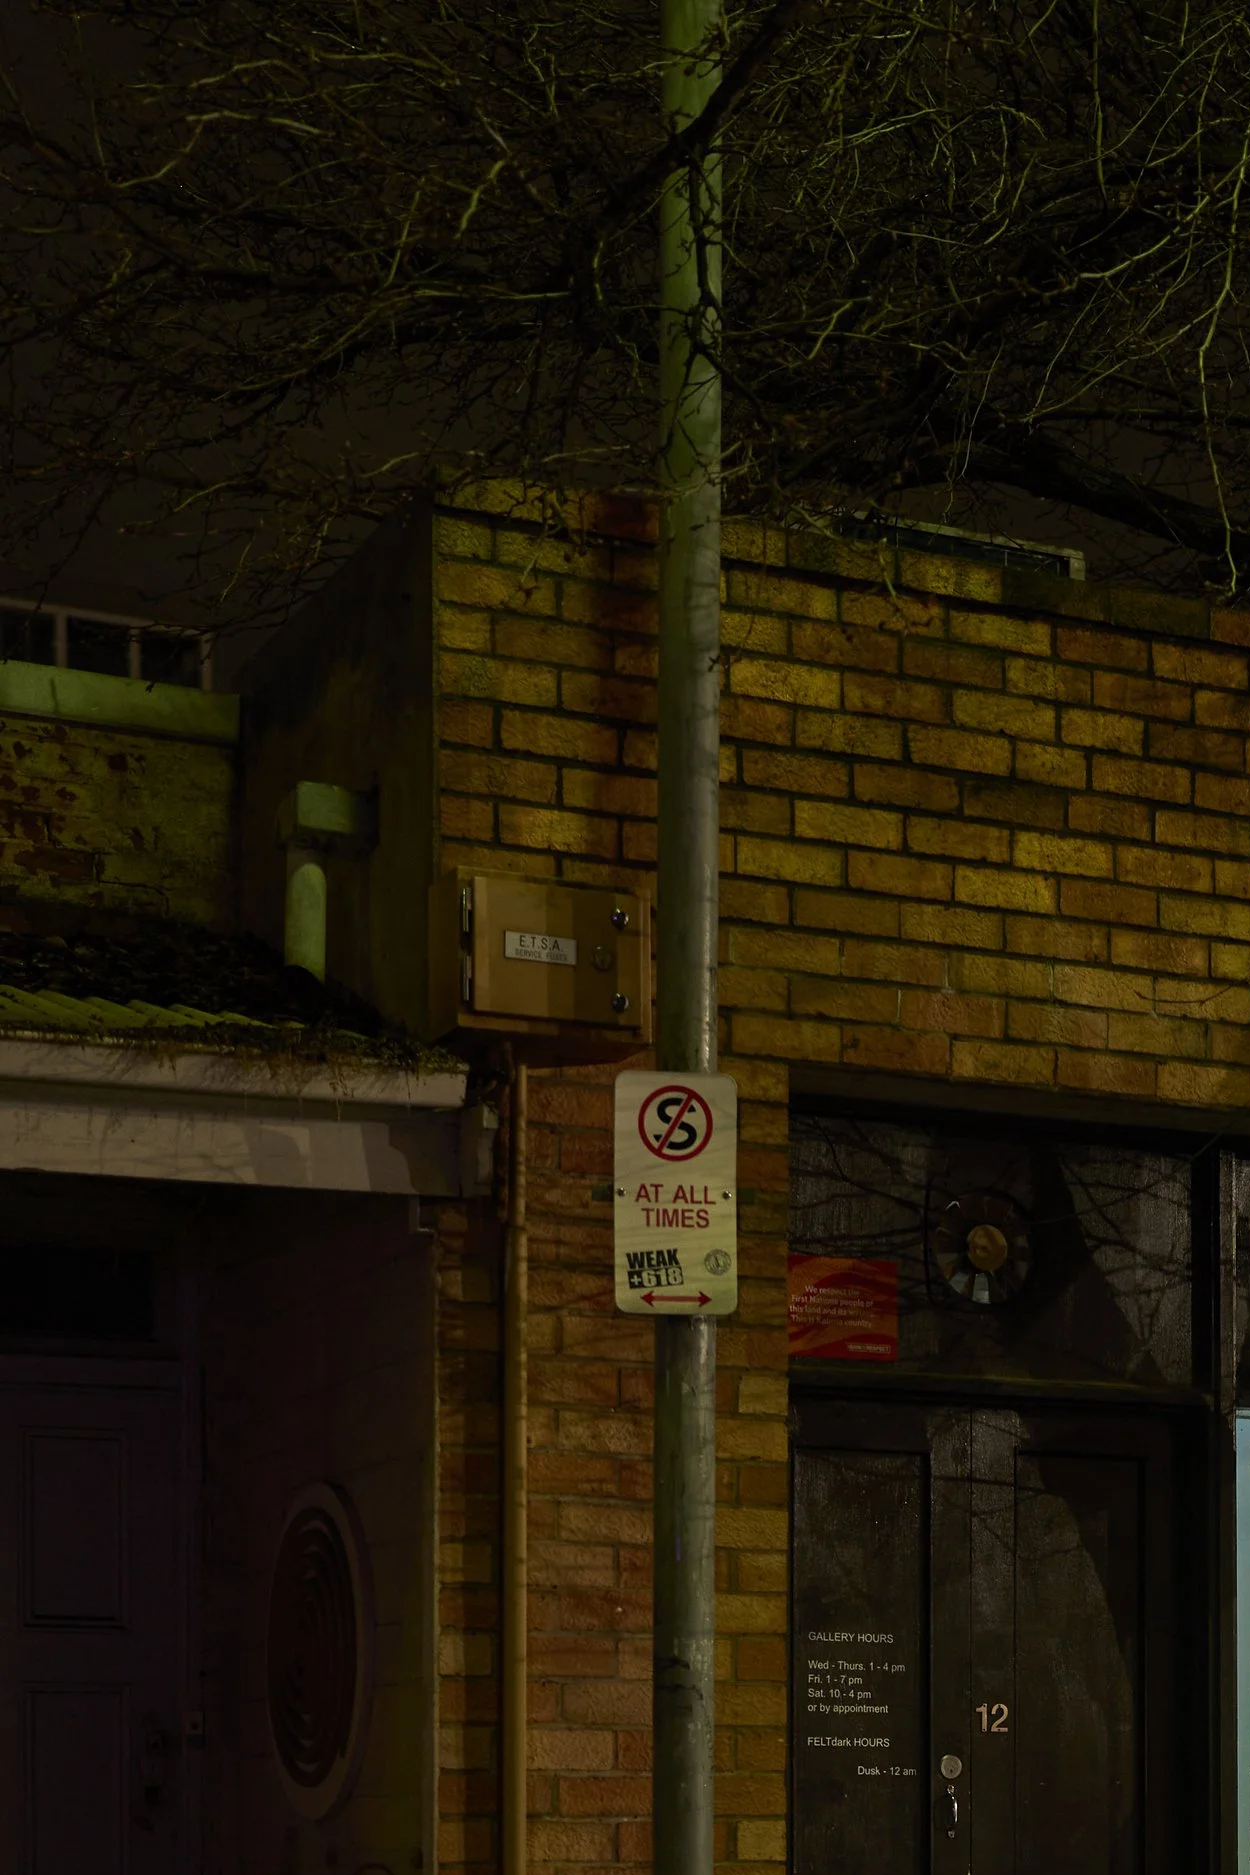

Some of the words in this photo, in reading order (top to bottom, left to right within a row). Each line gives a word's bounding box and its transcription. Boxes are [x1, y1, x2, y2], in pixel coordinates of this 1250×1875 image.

[520, 935, 564, 953] E.T.S.A.
[636, 1184, 664, 1203] AT
[673, 1185, 716, 1205] ALL
[642, 1208, 710, 1229] TIMES
[626, 1248, 681, 1269] WEAK
[630, 1267, 683, 1287] +618
[808, 1631, 855, 1642] GALLERY
[857, 1633, 894, 1643] HOURS
[808, 1660, 829, 1670] Wed
[837, 1661, 866, 1671] Thurs.
[869, 1662, 875, 1671] 1
[883, 1662, 889, 1671] 4
[891, 1664, 906, 1674] pm
[808, 1674, 823, 1684] Fri.
[826, 1674, 831, 1684] 1
[840, 1675, 846, 1684] 7
[848, 1676, 863, 1686] pm
[808, 1688, 826, 1698] Sat.
[829, 1689, 841, 1698] 10
[848, 1689, 855, 1698] 4
[857, 1691, 872, 1701] pm
[807, 1704, 817, 1712] or
[820, 1703, 831, 1714] by
[833, 1703, 889, 1715] appointment
[975, 1703, 1009, 1733] 12
[807, 1737, 852, 1747] FELTdark
[854, 1738, 890, 1748] HOURS
[857, 1766, 880, 1776] Dusk
[890, 1767, 900, 1776] 12
[903, 1768, 917, 1776] am
